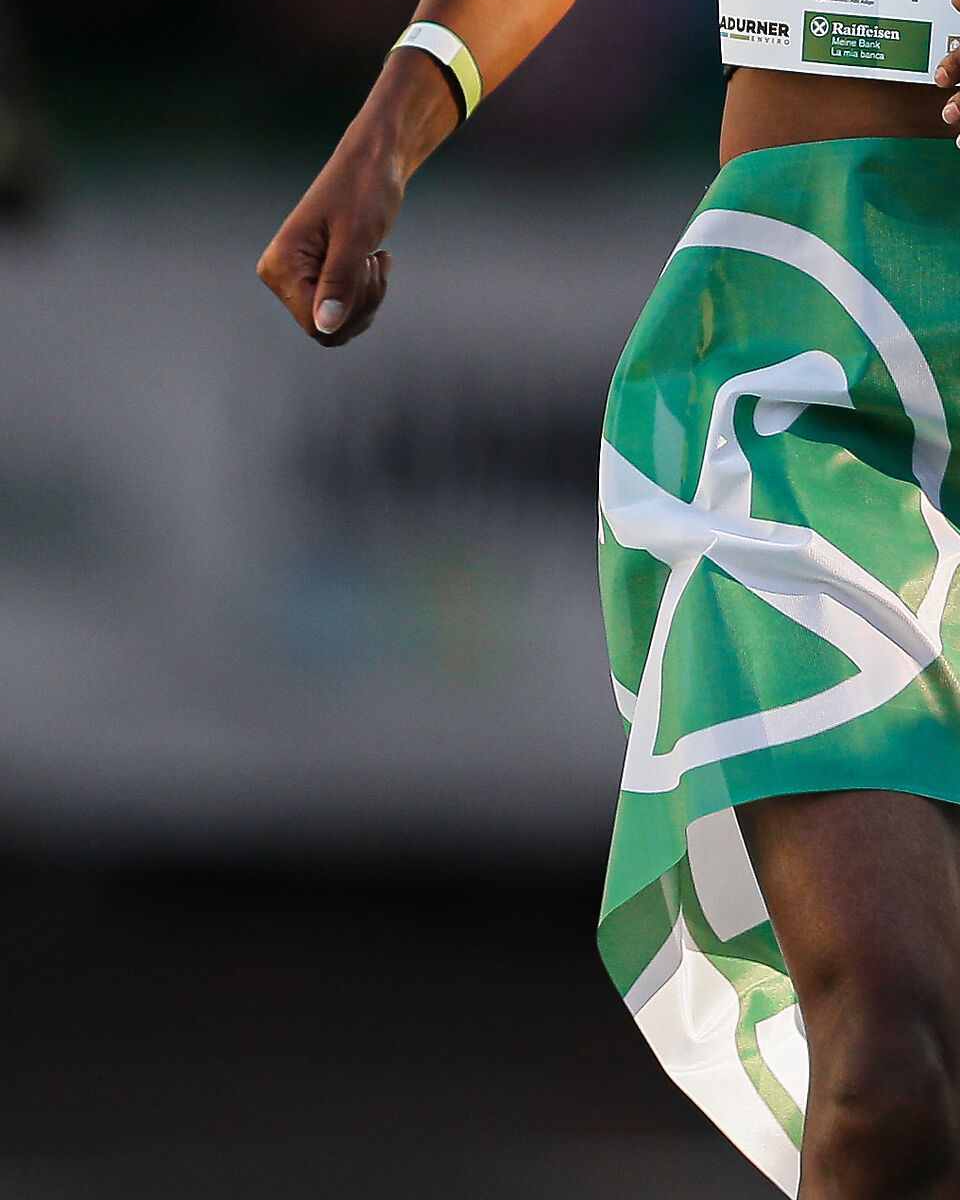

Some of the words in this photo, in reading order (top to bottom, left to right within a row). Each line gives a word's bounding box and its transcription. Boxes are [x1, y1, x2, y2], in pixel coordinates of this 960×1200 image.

[831, 22, 900, 40] Raiffeisen
[751, 35, 790, 46] ENVIRO
[831, 36, 857, 47] Meine
[858, 38, 881, 49] Bank
[831, 46, 842, 57] La
[843, 48, 859, 58] mia
[860, 49, 885, 60] banca
